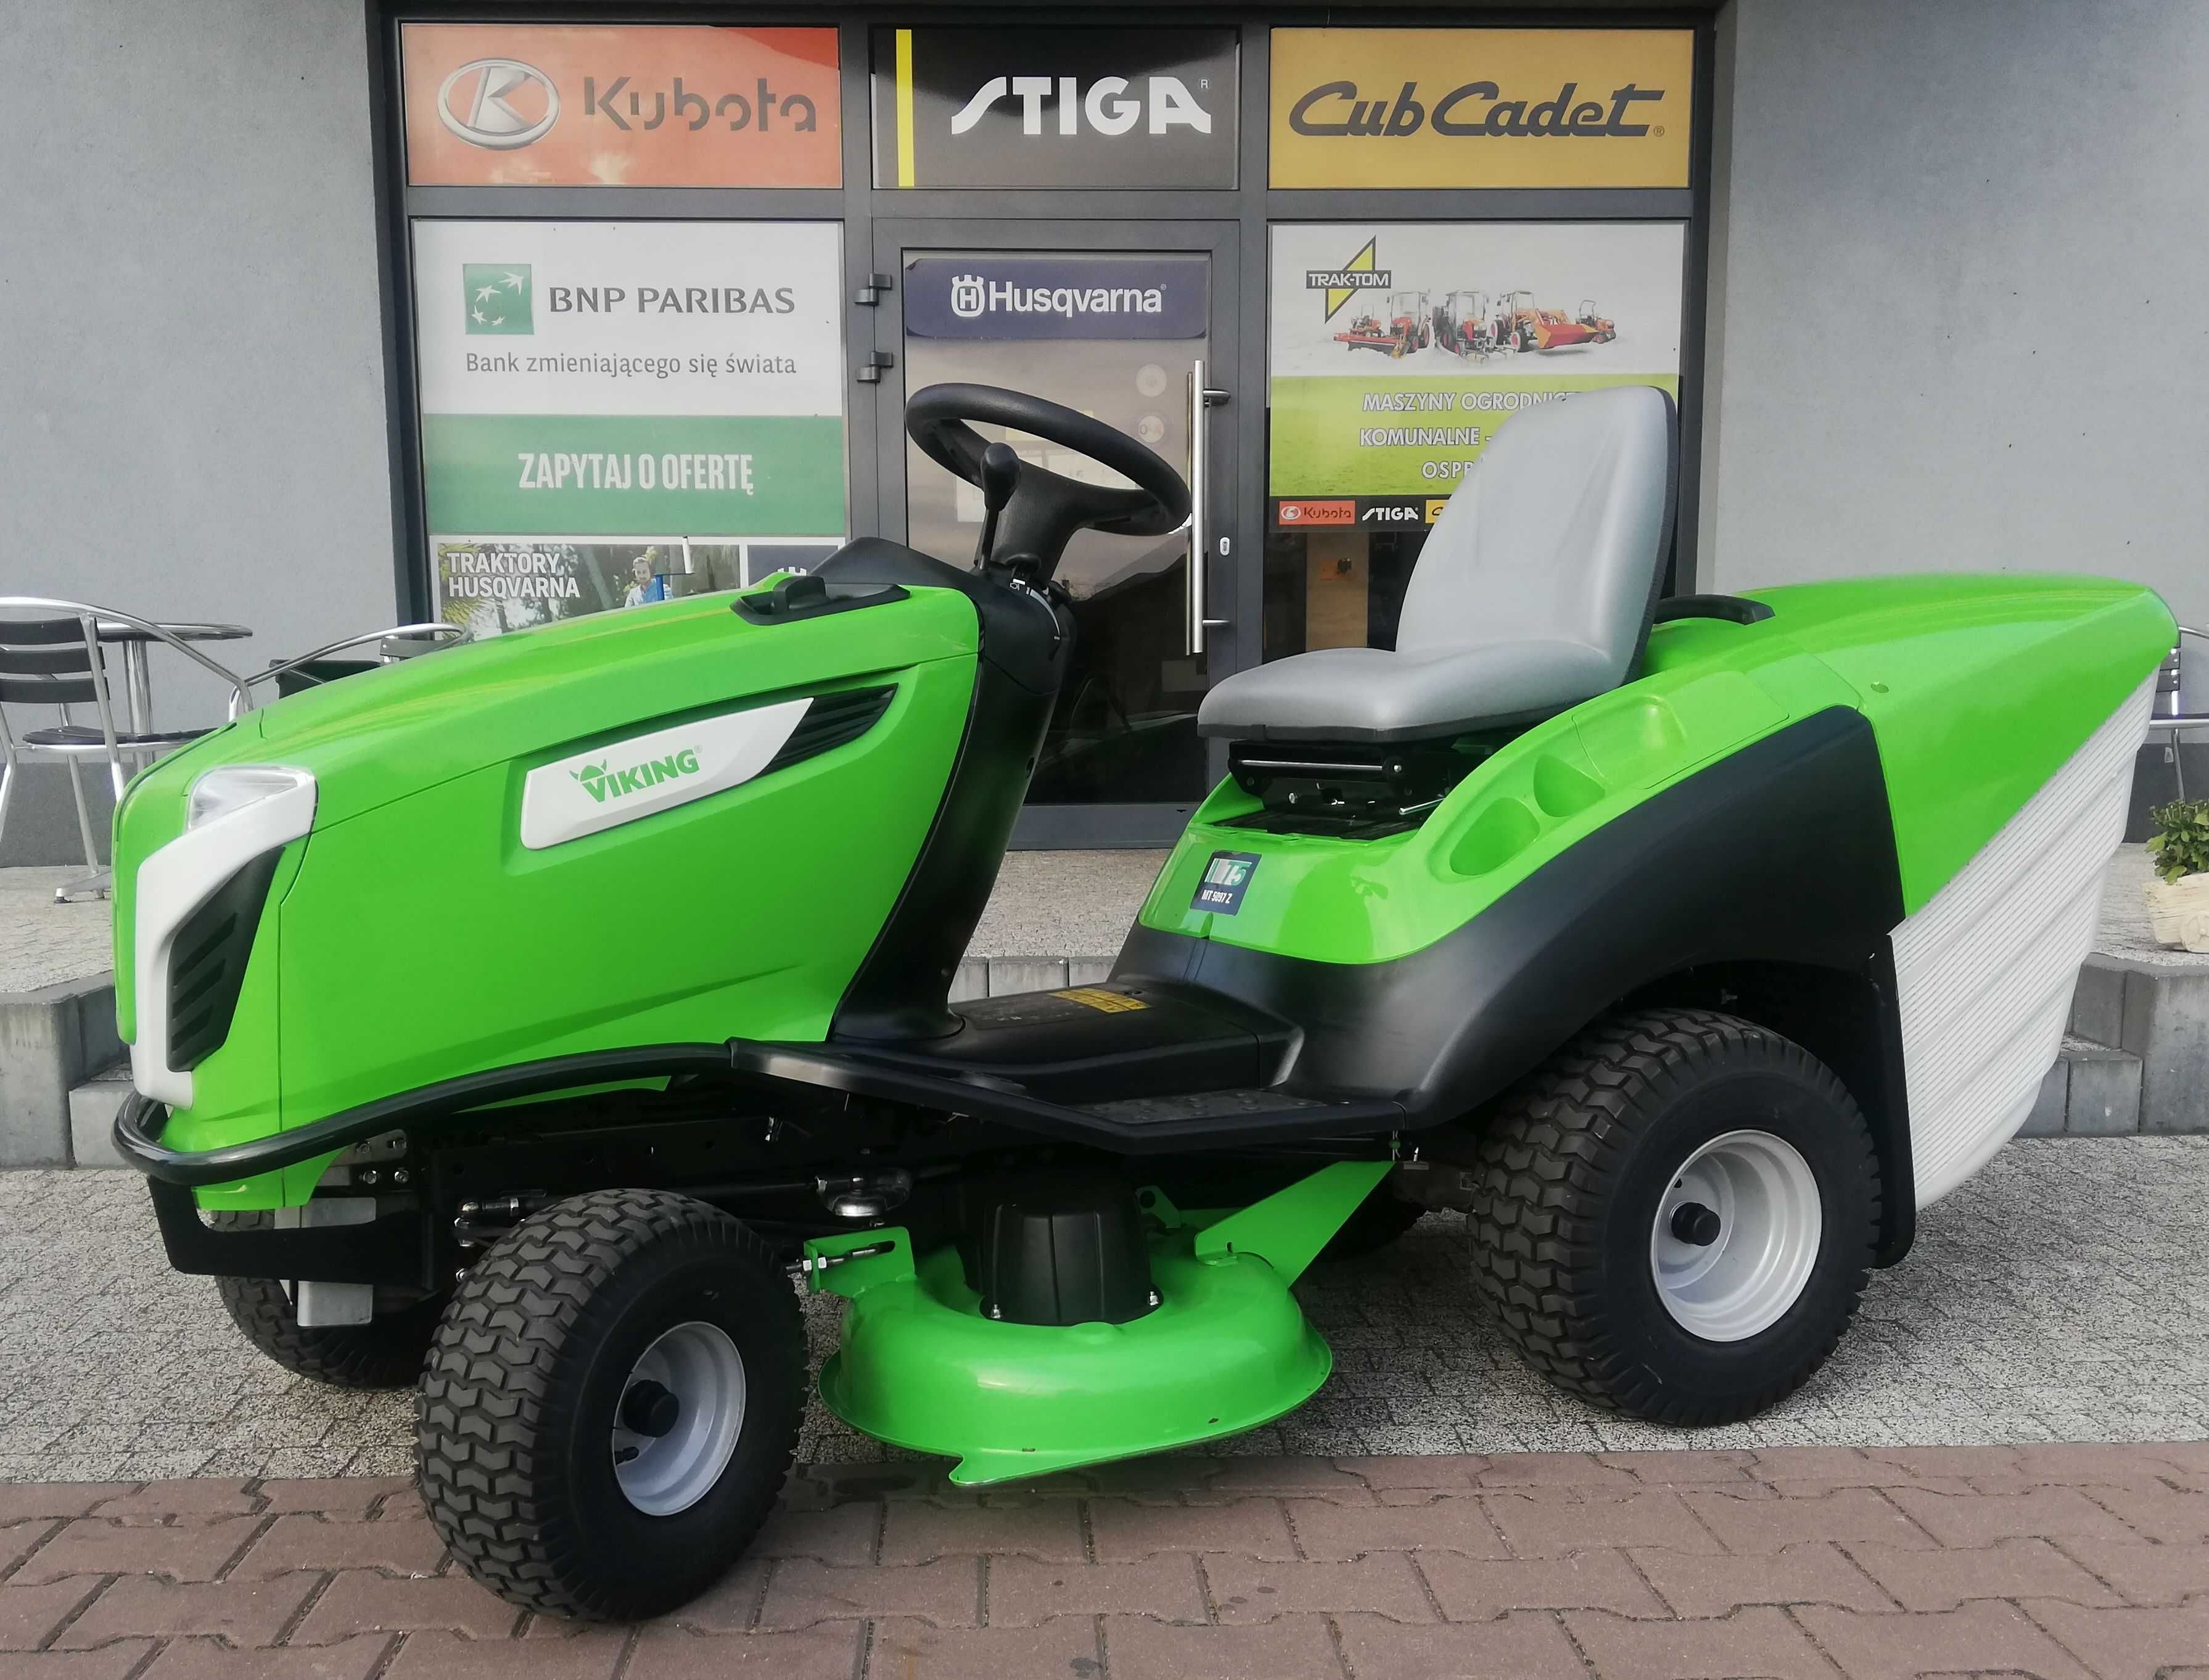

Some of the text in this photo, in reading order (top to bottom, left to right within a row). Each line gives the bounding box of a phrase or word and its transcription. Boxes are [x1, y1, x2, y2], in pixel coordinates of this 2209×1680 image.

[584, 76, 817, 132] Kubota
[952, 76, 1211, 135] STIGA
[1289, 81, 1664, 137] Cub Cadet
[1309, 273, 1389, 286] TRAK-TOM
[549, 287, 795, 314] BNP PARIBAS
[989, 281, 1162, 317] Husqvarna
[466, 352, 797, 379] Bank zmieniającego się świata
[1362, 393, 1457, 411] MASZYNY
[1359, 427, 1481, 446] KOMUNALNE
[518, 453, 754, 495] ZAPYTAJ O OFERTĘ
[1304, 507, 1352, 519] Kubota
[1362, 506, 1419, 521] STIGA
[446, 553, 560, 574] TRAKTORY
[449, 577, 580, 599] HUSQVARNA
[582, 749, 700, 802] VIKING
